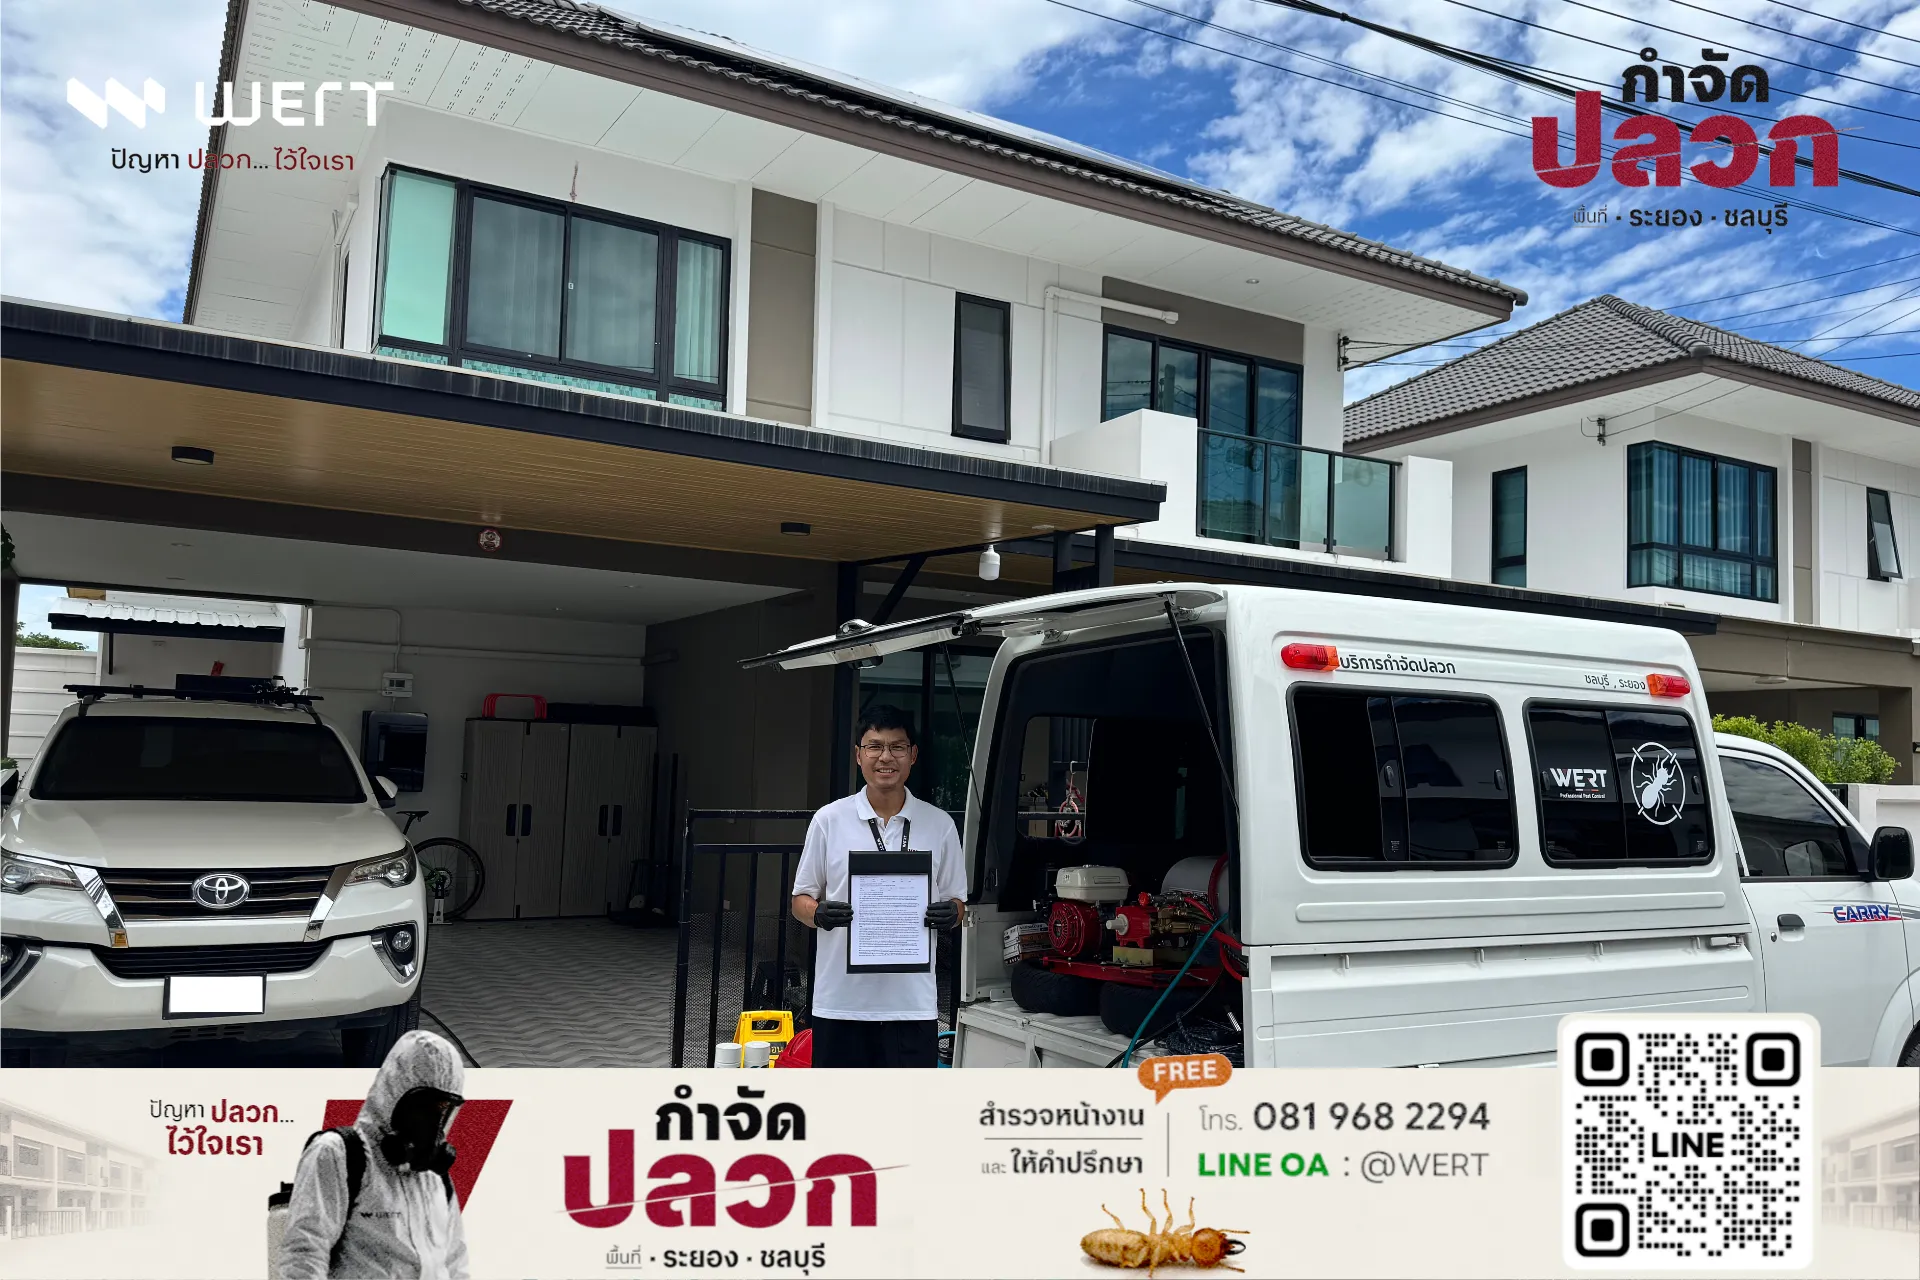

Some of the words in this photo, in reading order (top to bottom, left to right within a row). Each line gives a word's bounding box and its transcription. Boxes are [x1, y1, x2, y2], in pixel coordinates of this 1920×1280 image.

[1340, 653, 1456, 675] บริการกำจัดปลวก
[1584, 673, 1610, 690] ชลบุรี
[1618, 678, 1646, 691] ระยอง
[1550, 767, 1608, 788] WERT
[1832, 904, 1889, 922] CARRY
